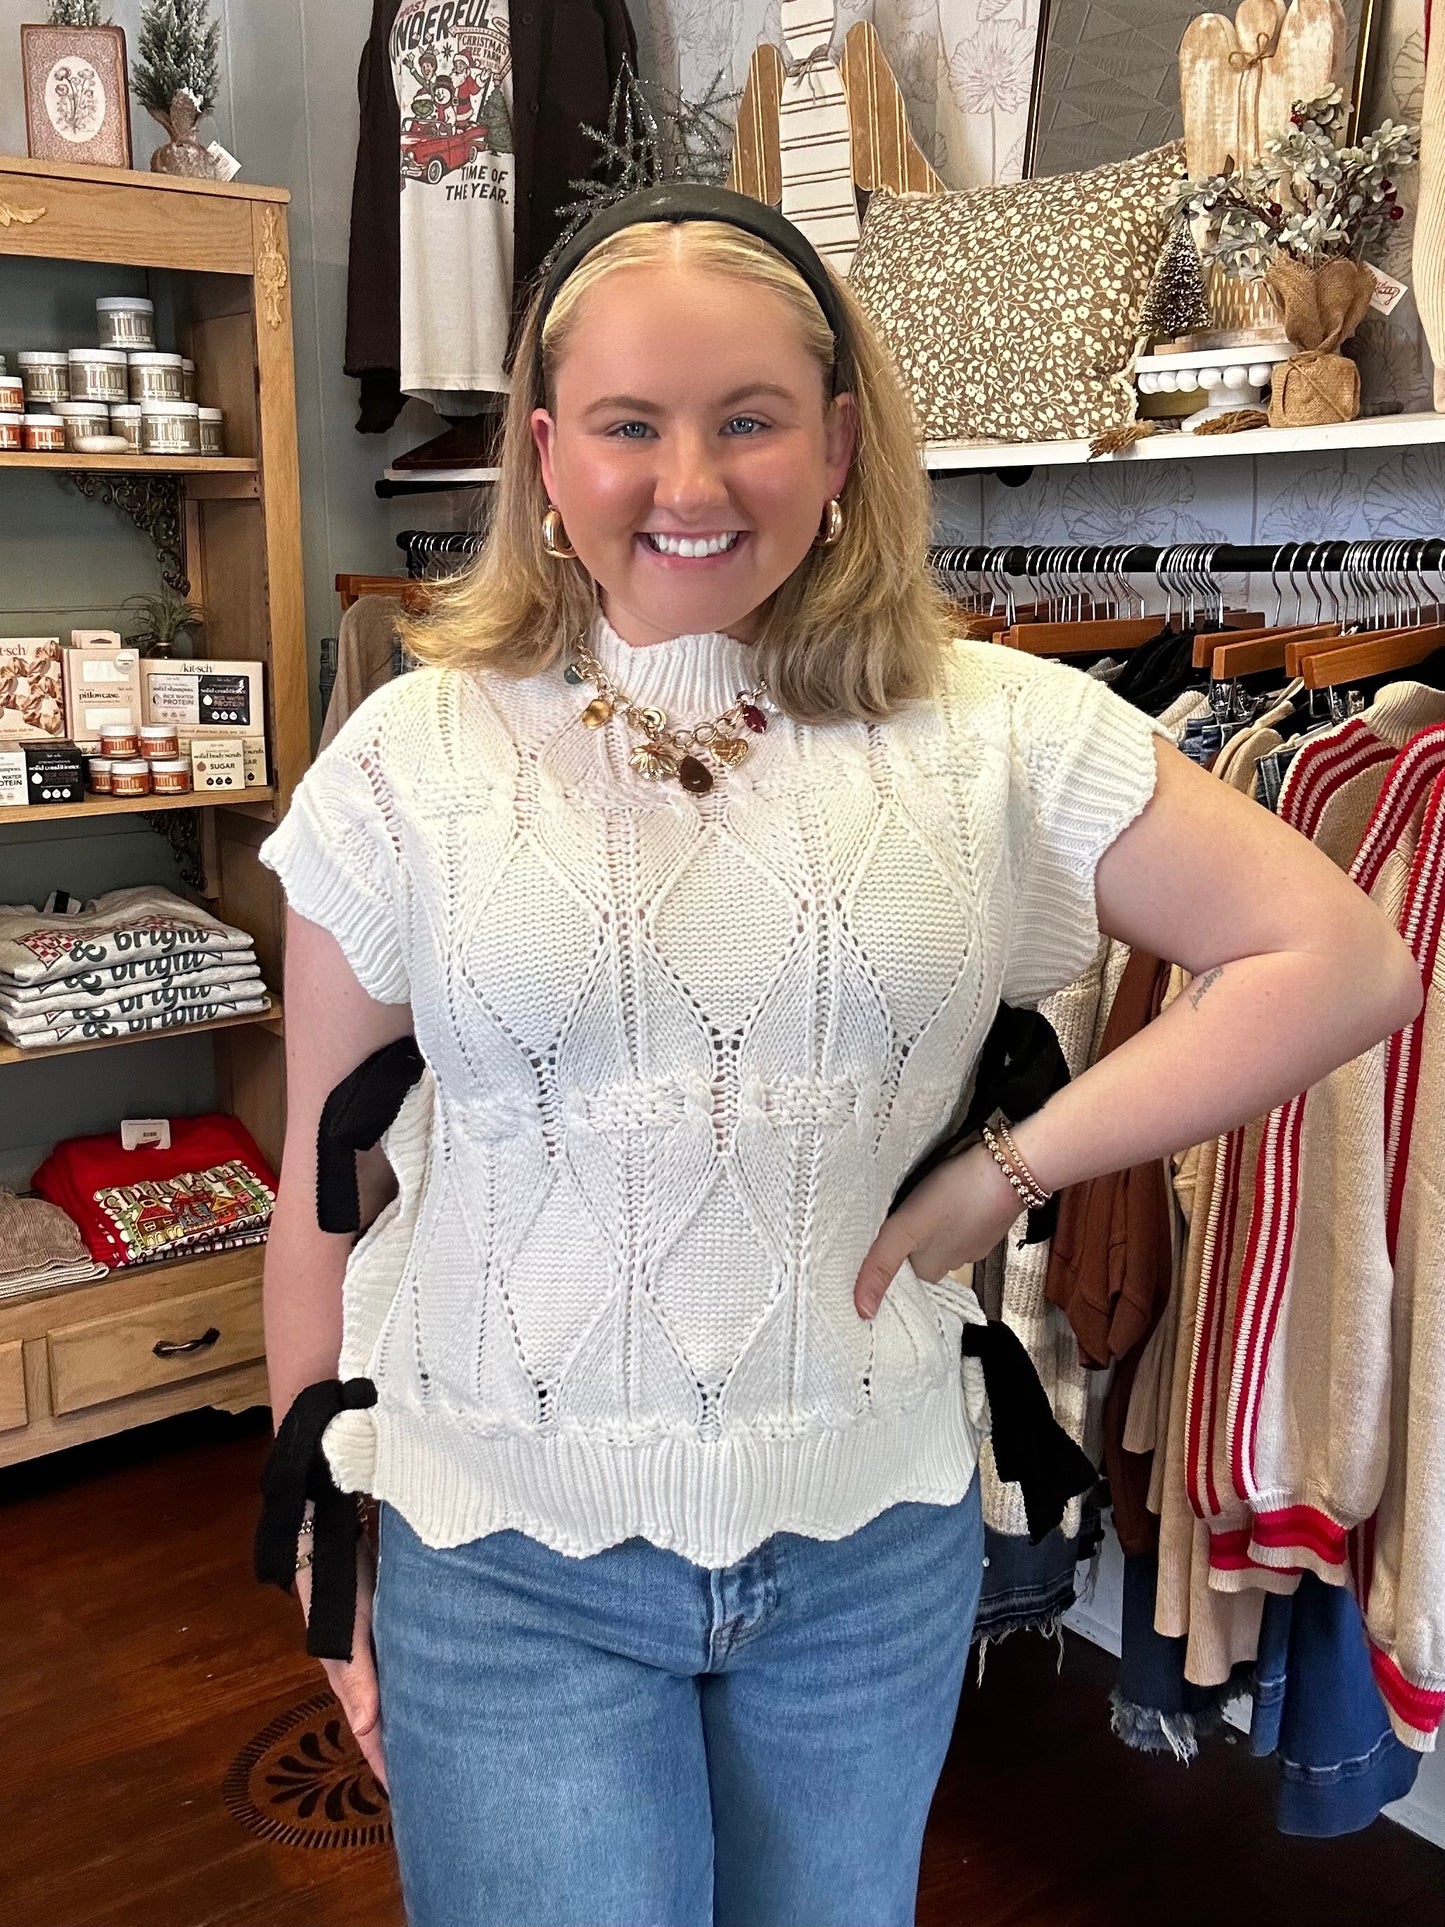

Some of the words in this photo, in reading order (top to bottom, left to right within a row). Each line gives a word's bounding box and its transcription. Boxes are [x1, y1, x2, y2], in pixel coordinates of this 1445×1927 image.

[462, 35, 509, 56] CHRISTMAS
[461, 166, 488, 182] TIME
[491, 170, 509, 185] OF
[446, 185, 468, 201] THE
[470, 183, 510, 205] YEAR.
